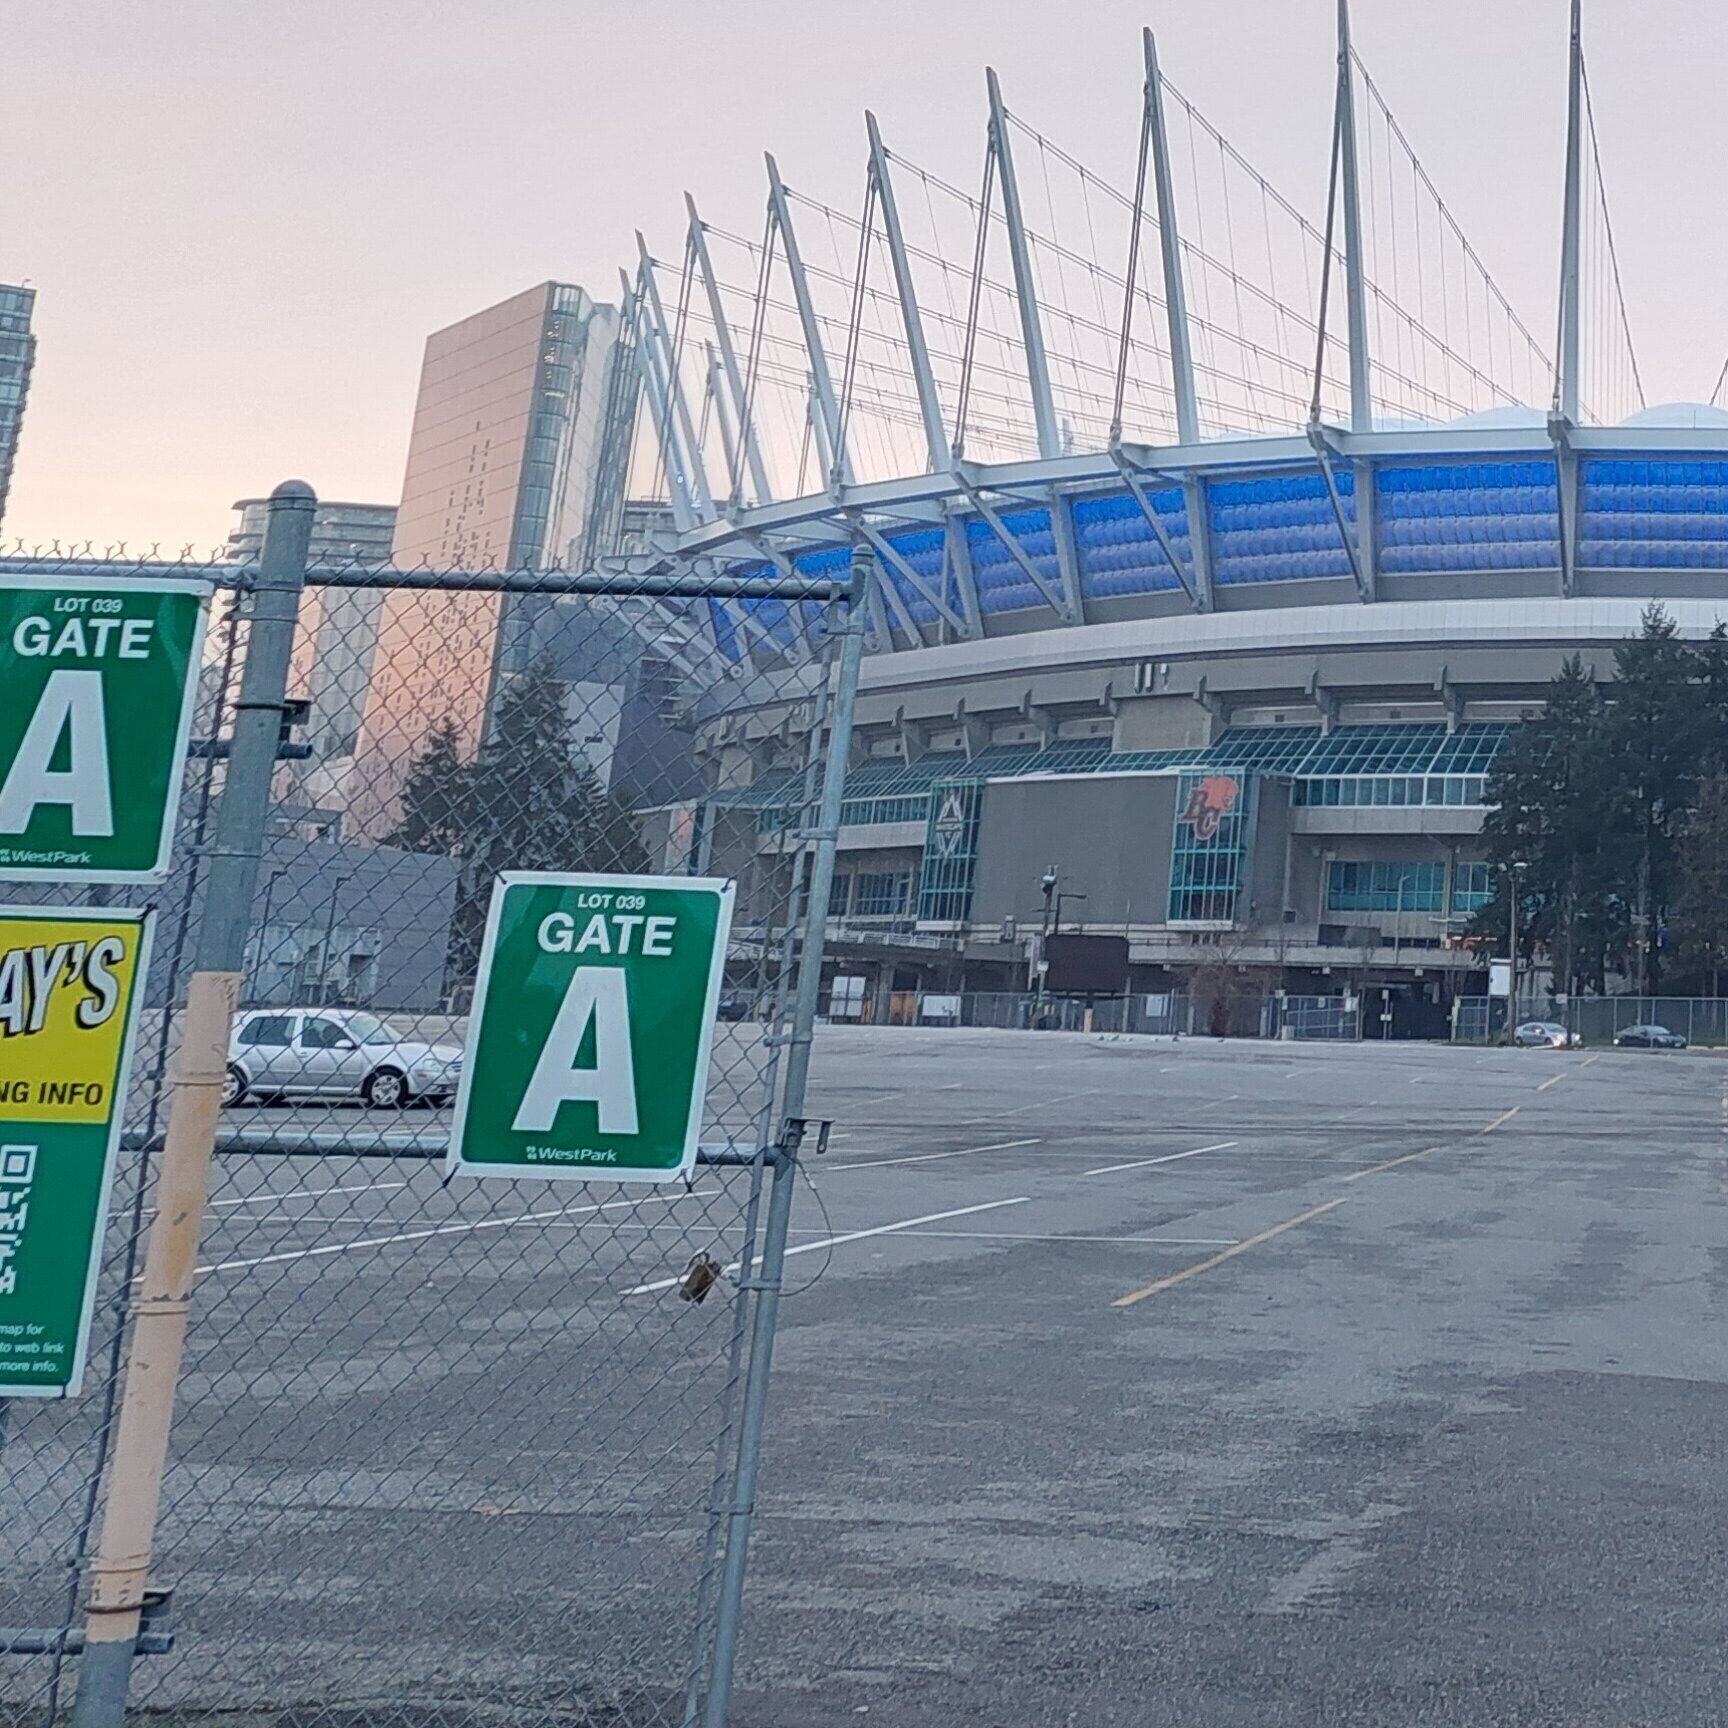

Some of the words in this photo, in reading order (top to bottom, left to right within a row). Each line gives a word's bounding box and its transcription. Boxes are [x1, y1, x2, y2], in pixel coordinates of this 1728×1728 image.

[54, 597, 91, 613] LOT
[92, 598, 124, 614] 039
[13, 616, 154, 659] GATE
[0, 669, 114, 836] A
[12, 850, 91, 864] WestPark
[577, 893, 613, 909] LOT
[615, 895, 646, 911] 039
[537, 912, 677, 957] GATE
[511, 966, 639, 1135] A
[38, 1081, 104, 1106] INFO
[538, 1146, 618, 1162] WestPark
[26, 1322, 45, 1335] for
[14, 1341, 40, 1353] web
[42, 1341, 65, 1354] link
[32, 1359, 60, 1373] info.
